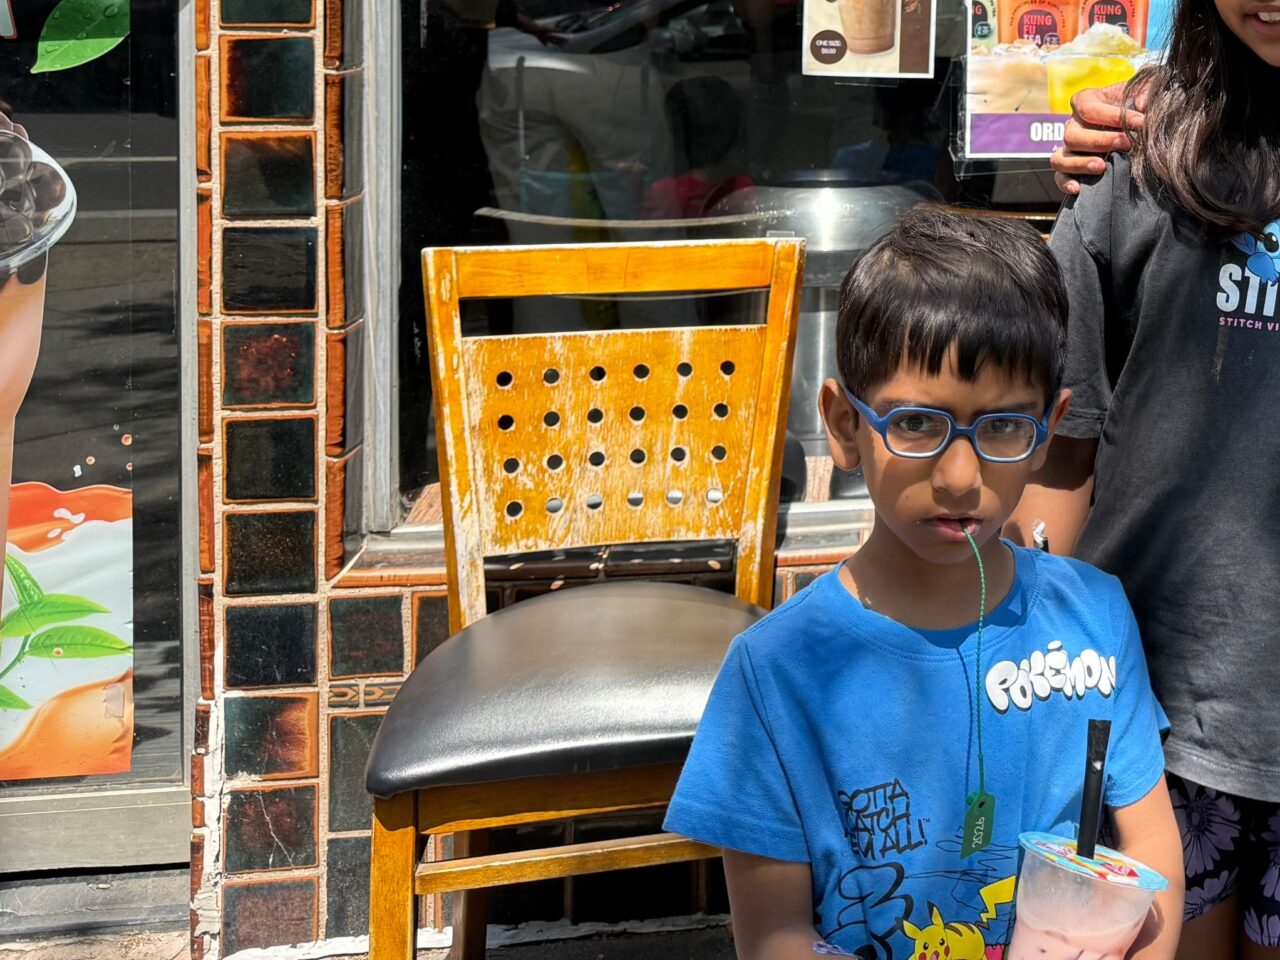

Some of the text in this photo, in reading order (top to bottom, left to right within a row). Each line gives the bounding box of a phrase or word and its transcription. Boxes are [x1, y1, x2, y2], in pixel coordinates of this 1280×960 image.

[1094, 4, 1122, 15] KUNG
[1023, 14, 1052, 26] KUNG
[1023, 25, 1036, 34] FU
[1030, 122, 1064, 141] ORD
[1219, 317, 1262, 330] STITCH
[971, 816, 985, 848] 2026
